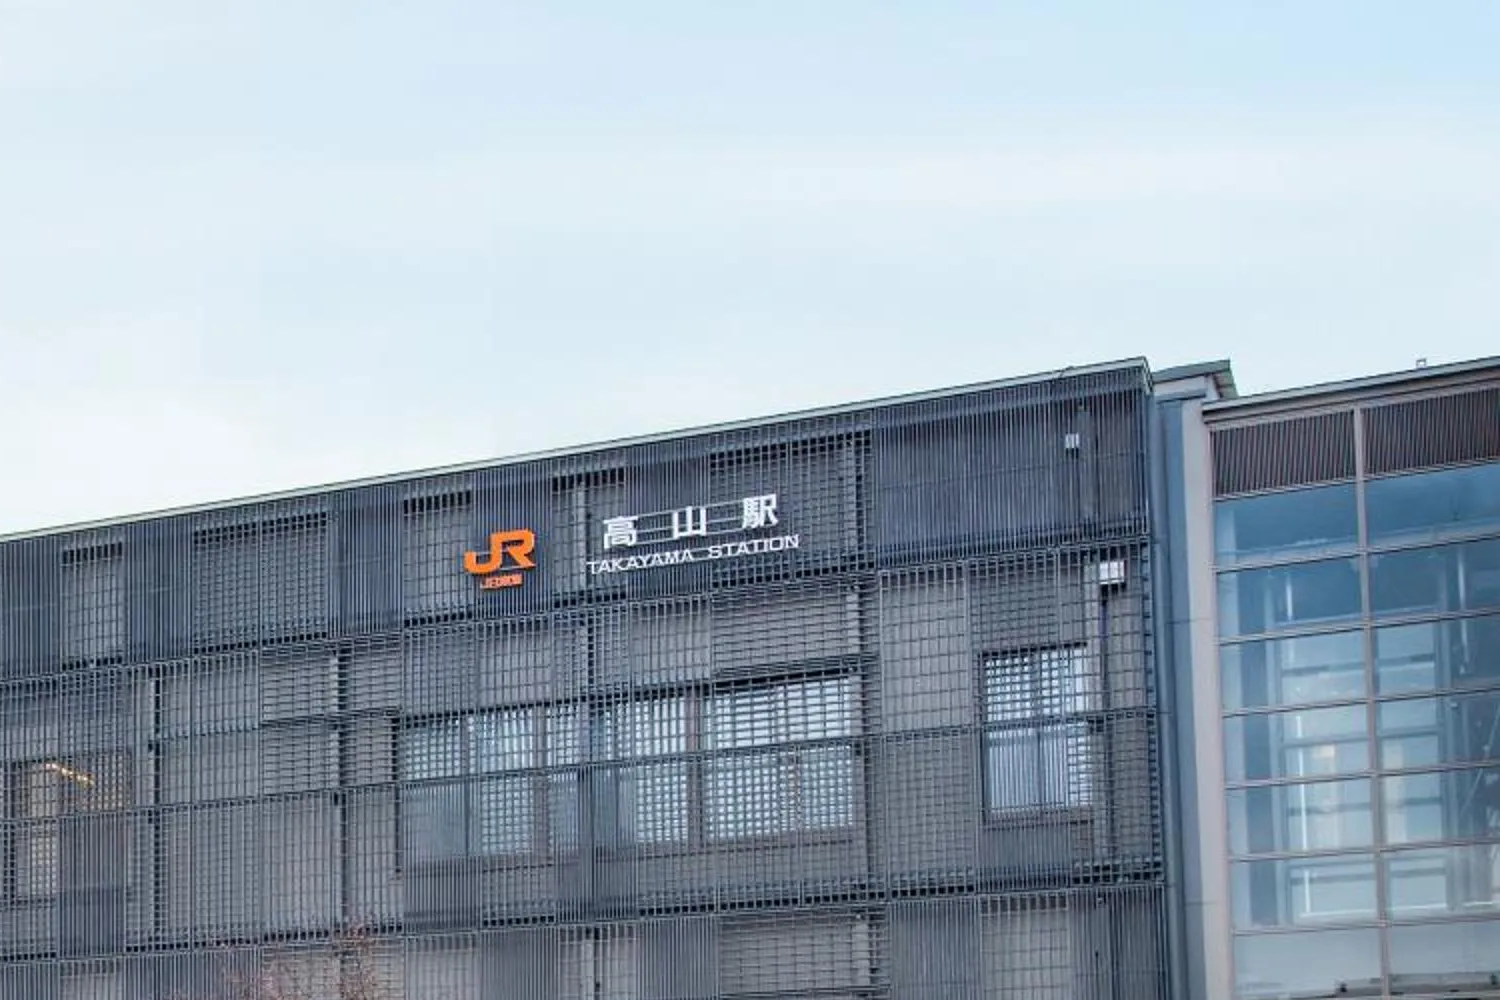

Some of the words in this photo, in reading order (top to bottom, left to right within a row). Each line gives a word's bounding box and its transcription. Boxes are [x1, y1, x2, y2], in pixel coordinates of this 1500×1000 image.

[603, 493, 779, 549] 高山駅
[462, 527, 536, 575] JR
[587, 549, 694, 574] TAKAYAMA
[708, 534, 799, 559] STATION
